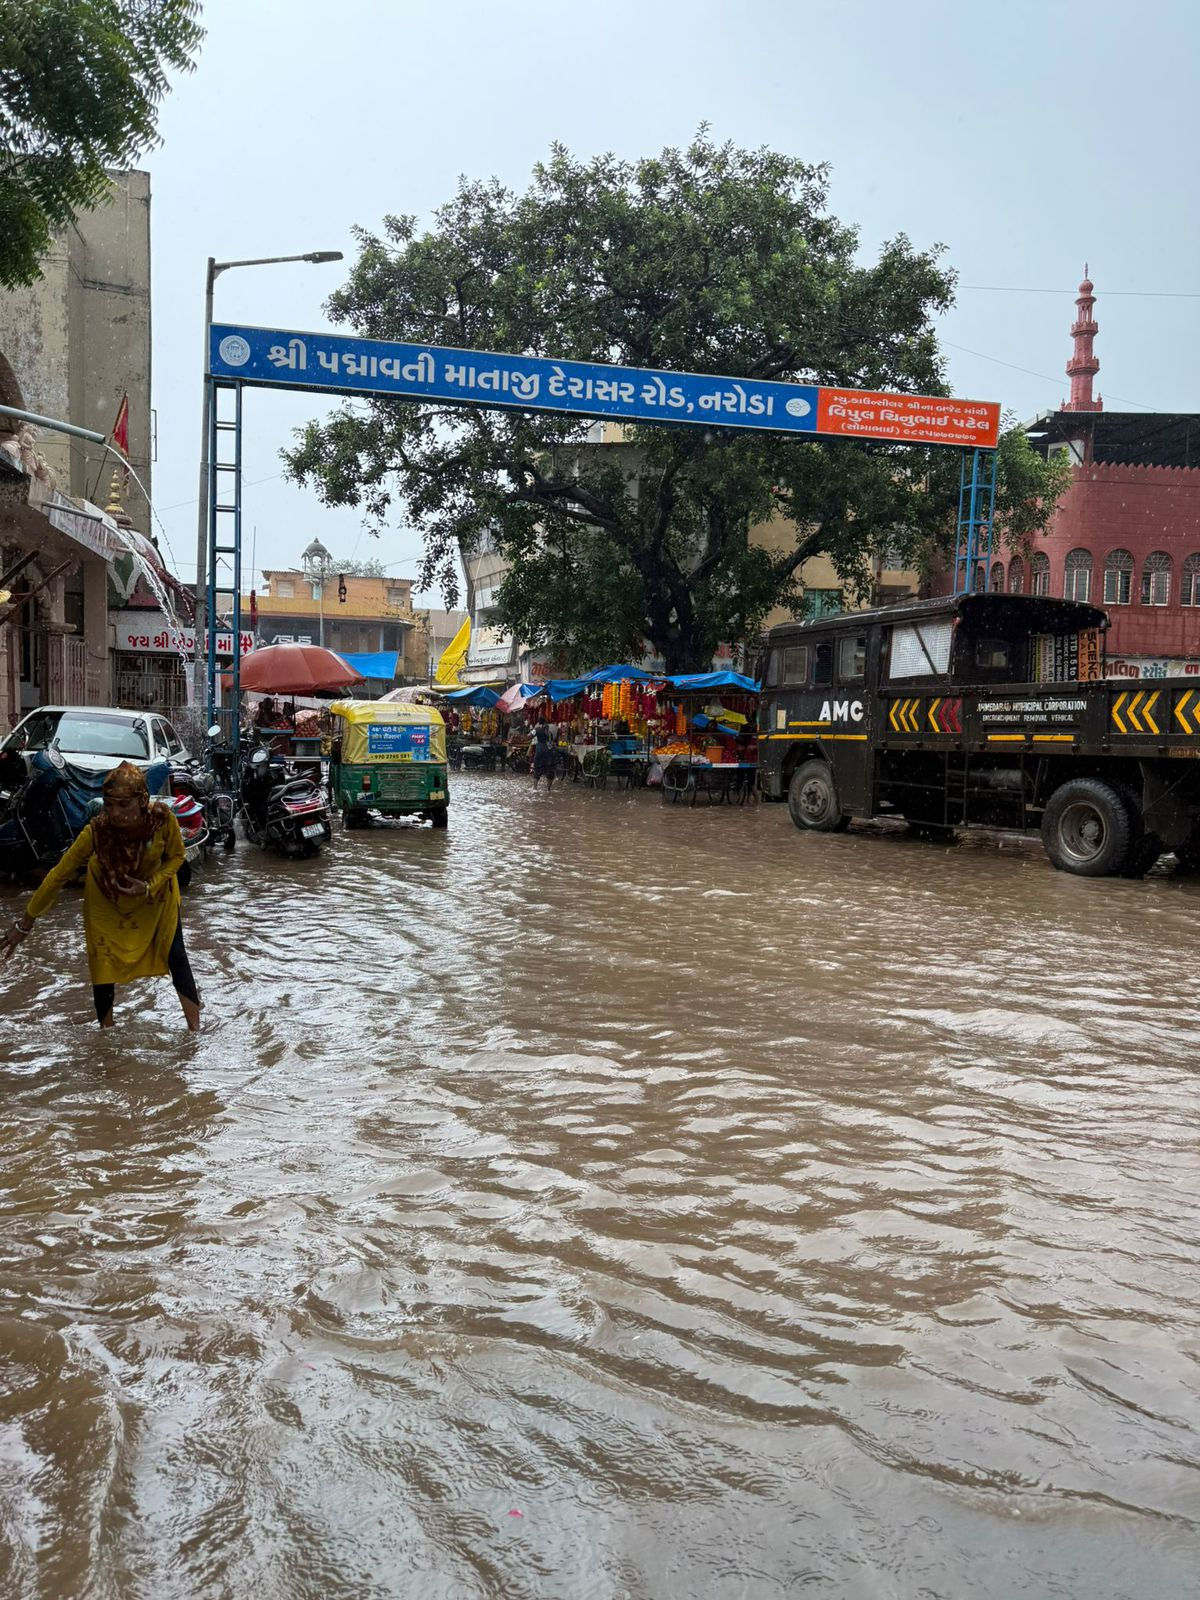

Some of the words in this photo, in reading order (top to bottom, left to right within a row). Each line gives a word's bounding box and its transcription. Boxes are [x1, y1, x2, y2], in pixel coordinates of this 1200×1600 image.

[267, 338, 307, 370] શ્રી
[317, 350, 435, 384] પદ્માવતી
[445, 364, 540, 400] માતાજી
[548, 366, 635, 403] દેરાસર
[698, 384, 774, 416] નરોડા
[828, 404, 875, 422] વિપુલ
[952, 416, 990, 430] પટેલ
[128, 635, 150, 648] જય
[153, 631, 169, 649] શ્રી
[217, 635, 232, 652] માં
[271, 634, 312, 645] ASUS
[1088, 631, 1097, 680] SCIENC
[819, 701, 864, 722] AMC
[1045, 700, 1087, 711] CORPORATION
[1024, 714, 1047, 722] REMOVAL
